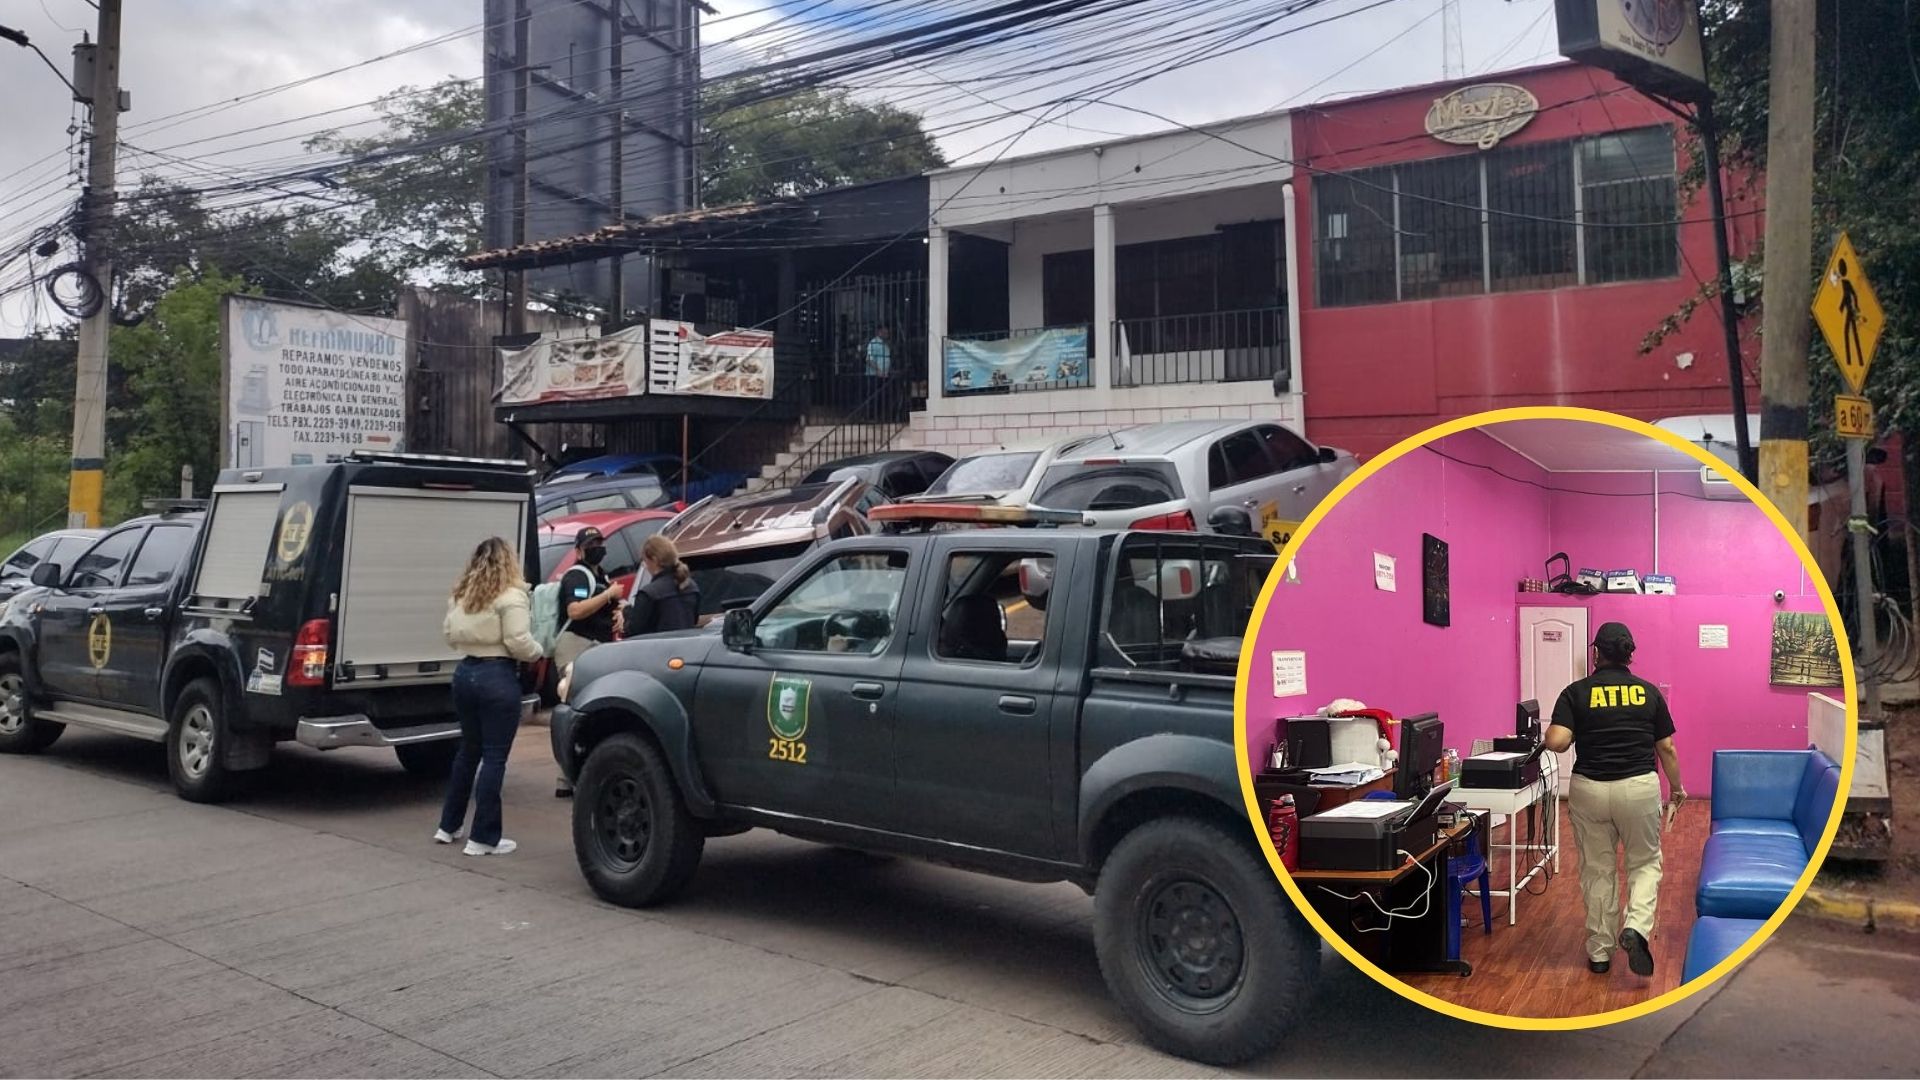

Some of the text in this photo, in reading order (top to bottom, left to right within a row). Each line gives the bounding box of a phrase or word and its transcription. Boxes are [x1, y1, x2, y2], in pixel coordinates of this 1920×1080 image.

[279, 363, 303, 375] TODO
[281, 349, 402, 373] REPARAMOS VENDEMOS
[285, 375, 307, 388] AIRE
[310, 377, 382, 393] ACONDICIONADO
[345, 394, 357, 404] EN
[361, 395, 398, 406] GENERAL
[281, 402, 401, 418] TRABAJOS GARANTIZADOS
[1840, 409, 1847, 427] a
[1590, 684, 1648, 709] ATIC
[769, 738, 807, 764] 2512
